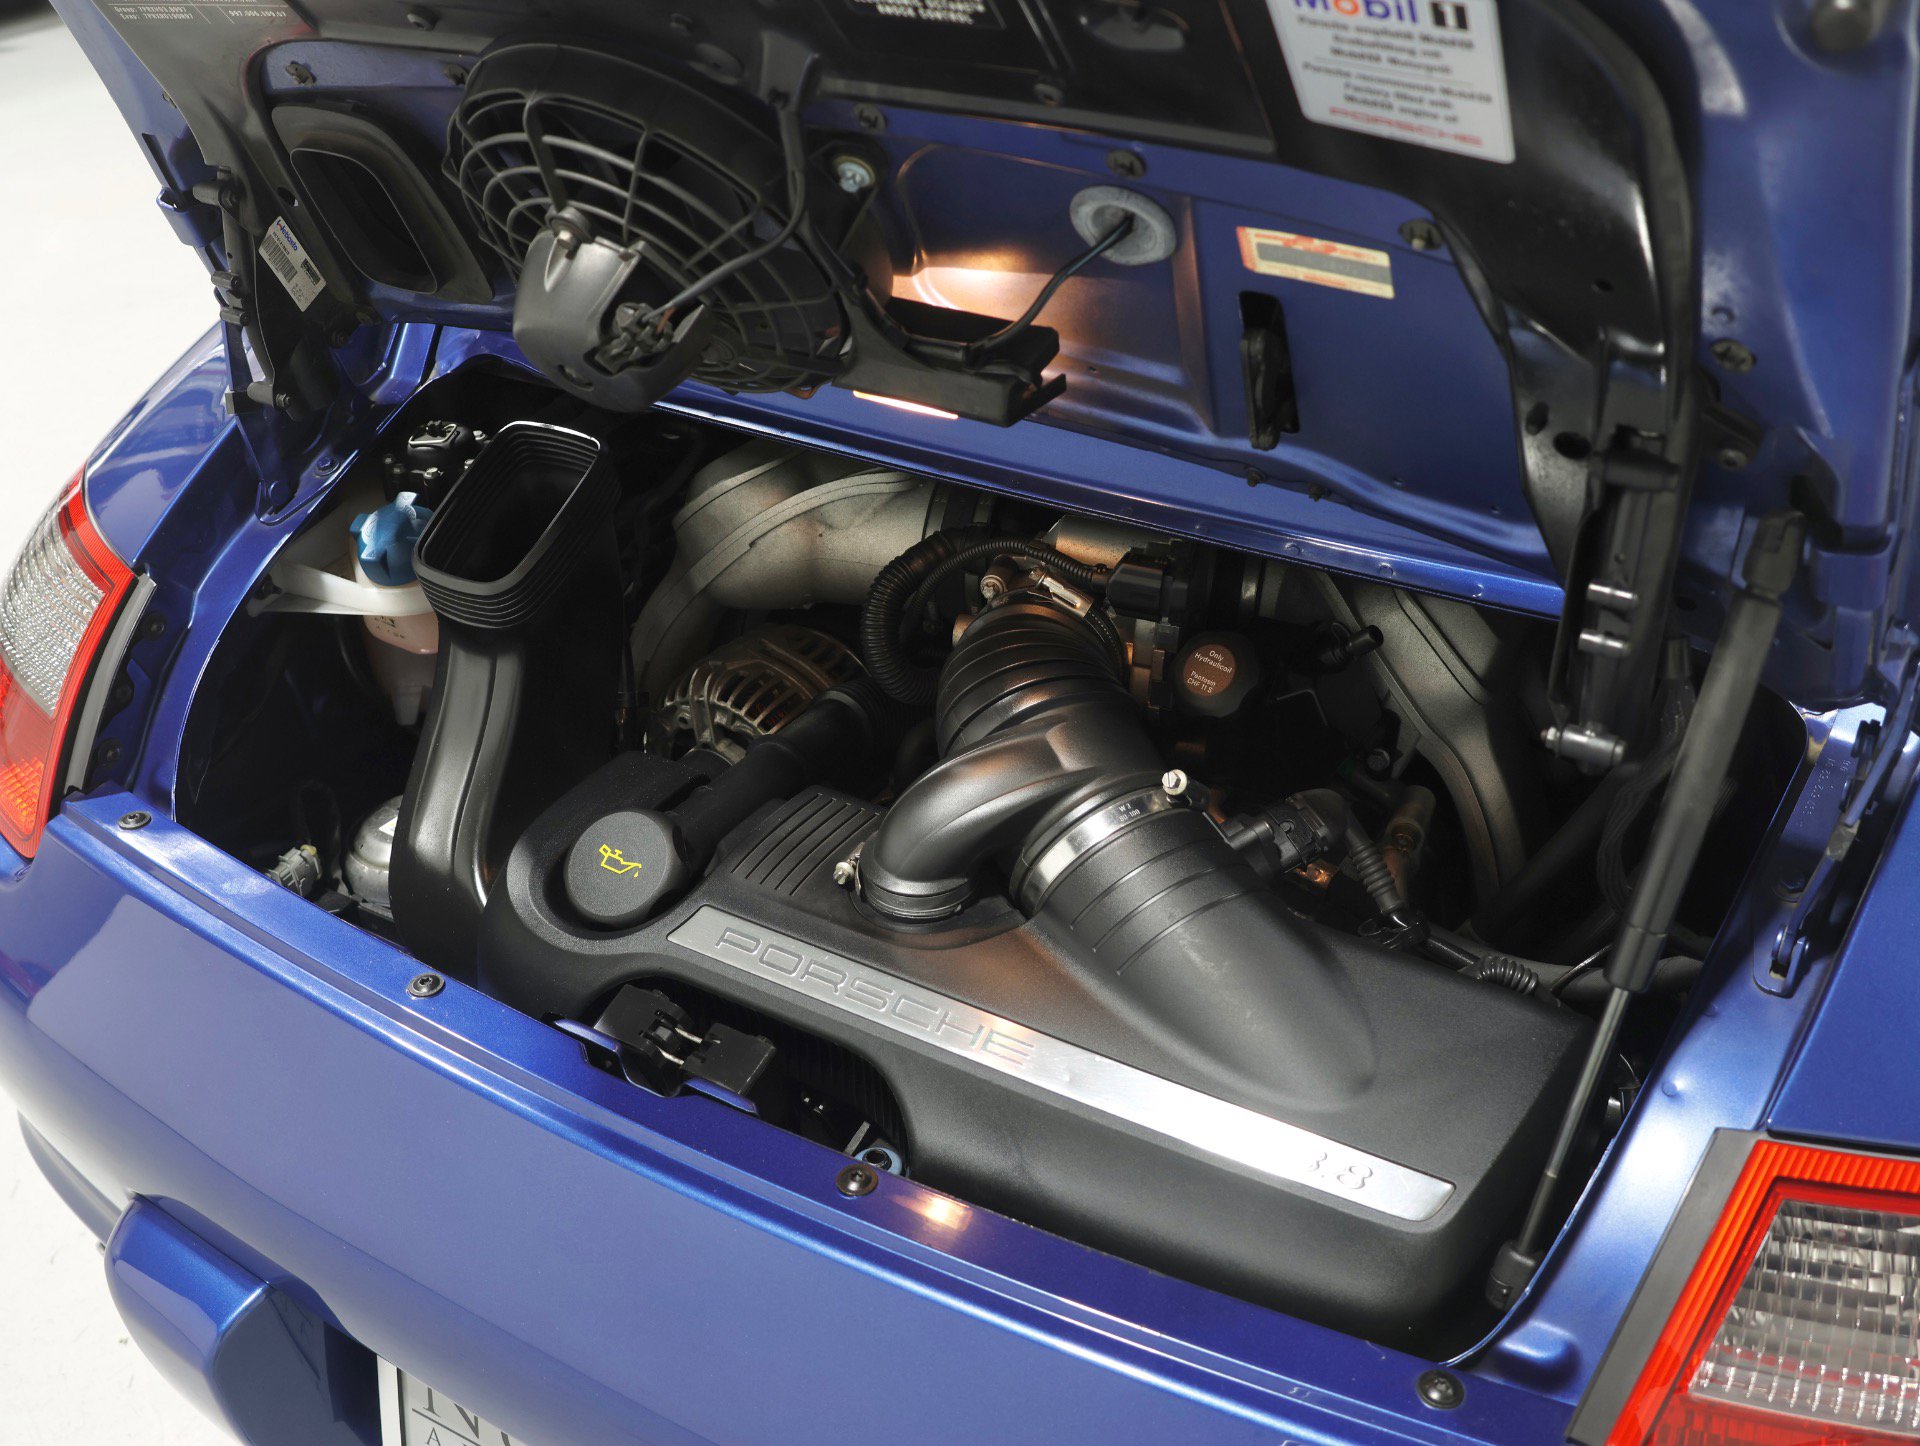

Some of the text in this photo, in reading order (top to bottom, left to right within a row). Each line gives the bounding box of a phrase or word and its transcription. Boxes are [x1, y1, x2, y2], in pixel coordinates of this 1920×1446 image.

[276, 219, 298, 251] Webasto
[1194, 652, 1233, 673] Hydraulicoil
[1209, 650, 1224, 662] Only
[1187, 677, 1201, 687] CHF
[714, 926, 1037, 1066] PORSCHE
